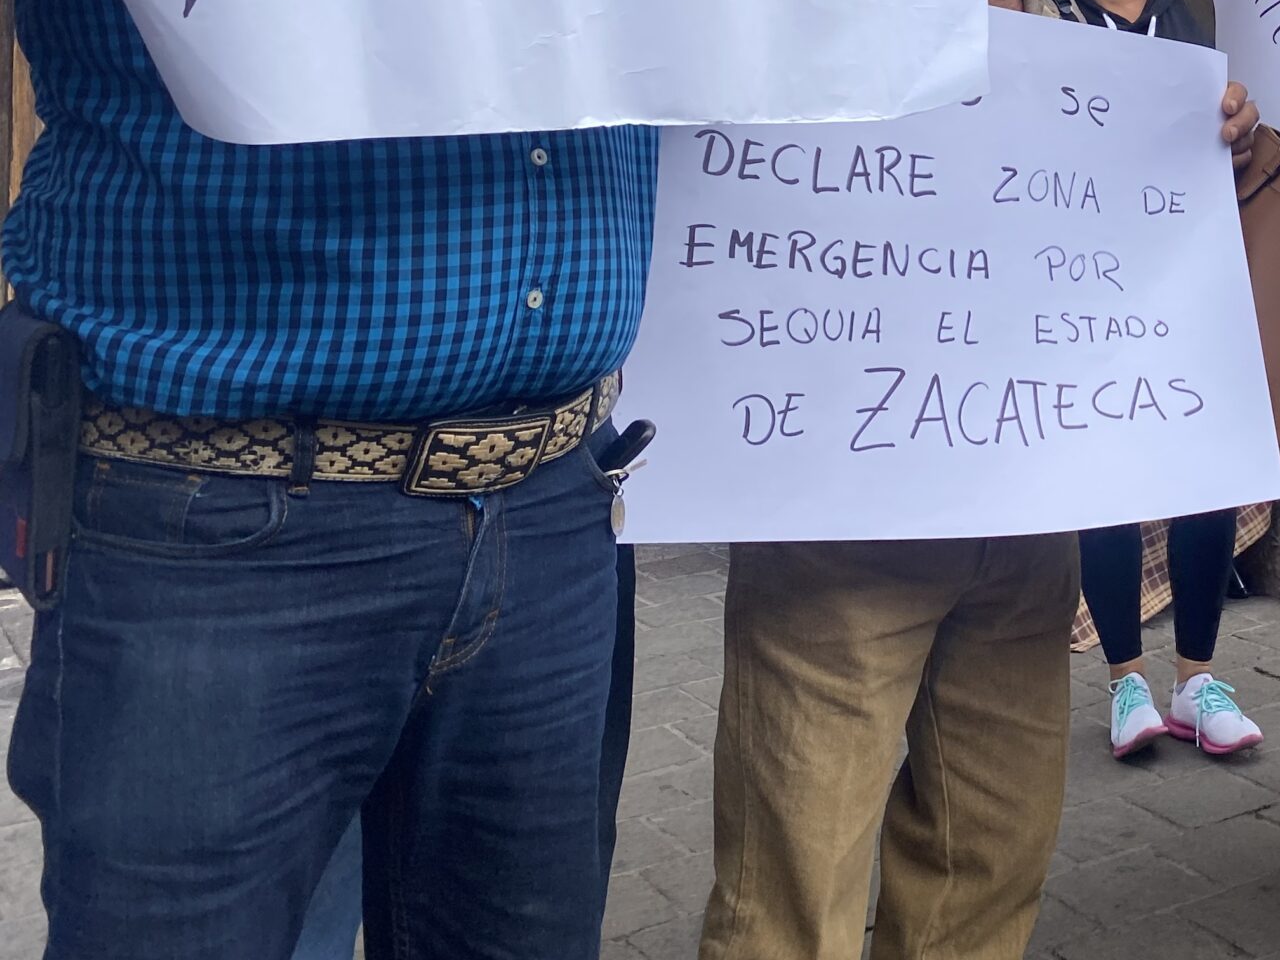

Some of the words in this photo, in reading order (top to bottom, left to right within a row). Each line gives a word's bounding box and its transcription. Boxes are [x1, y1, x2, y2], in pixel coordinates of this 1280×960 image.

[693, 128, 937, 198] DECLARE
[992, 166, 1102, 214] ZONA
[1142, 185, 1187, 216] DE
[678, 223, 990, 281] EMERGENCIA
[1034, 245, 1125, 292] POR
[717, 307, 882, 348] SEQUIA
[937, 309, 980, 346] EL
[1034, 313, 1170, 345] ESTADO
[732, 392, 806, 446] DE
[849, 366, 1205, 453] ZACATECAS
